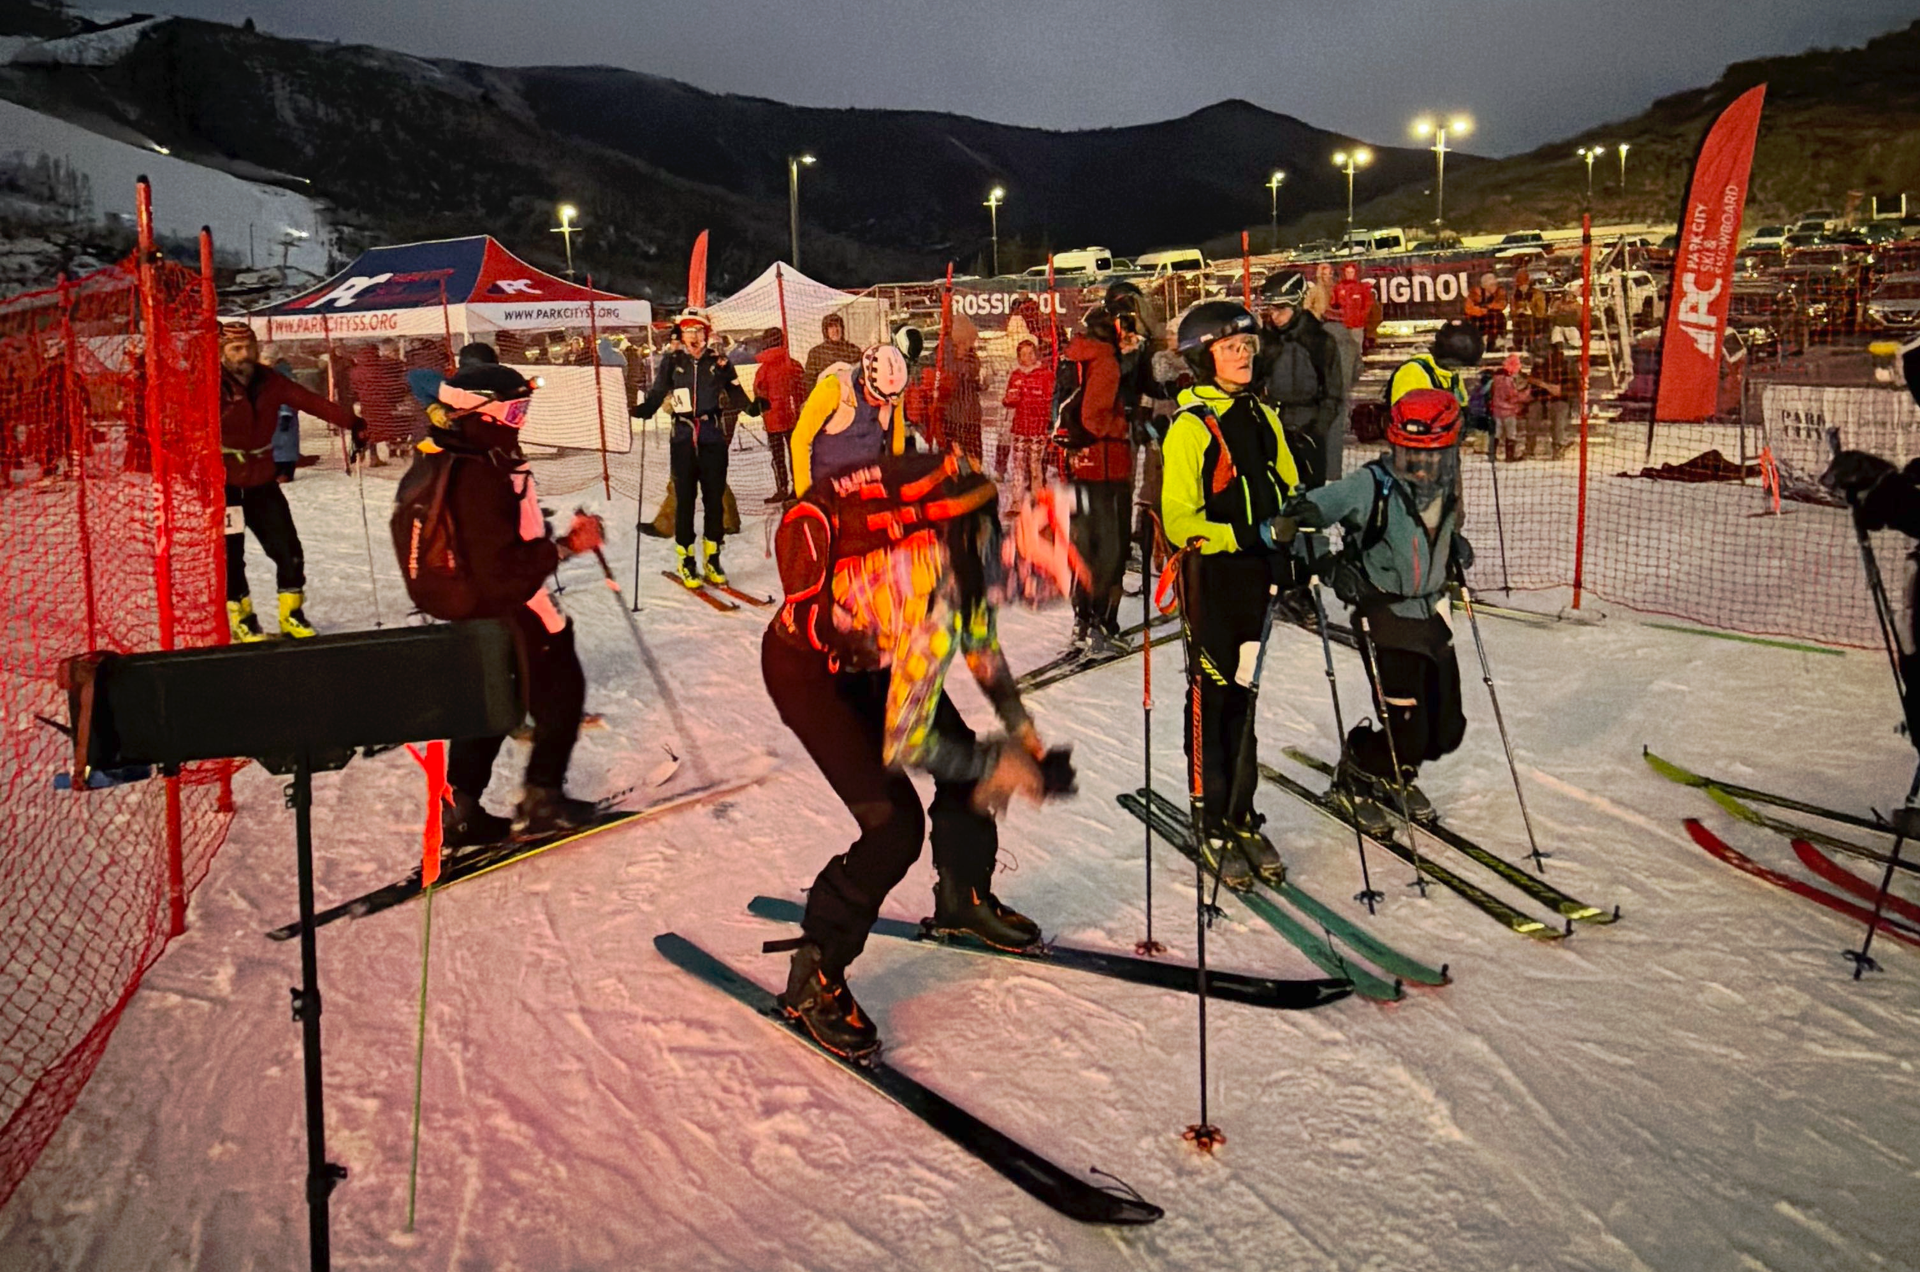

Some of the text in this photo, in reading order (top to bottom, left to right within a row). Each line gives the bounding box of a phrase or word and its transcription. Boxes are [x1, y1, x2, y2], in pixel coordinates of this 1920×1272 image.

[1692, 203, 1708, 234] CITY
[504, 307, 620, 321] WWW.PARKCITYS.ORG
[952, 292, 1067, 315] ROSSIOL
